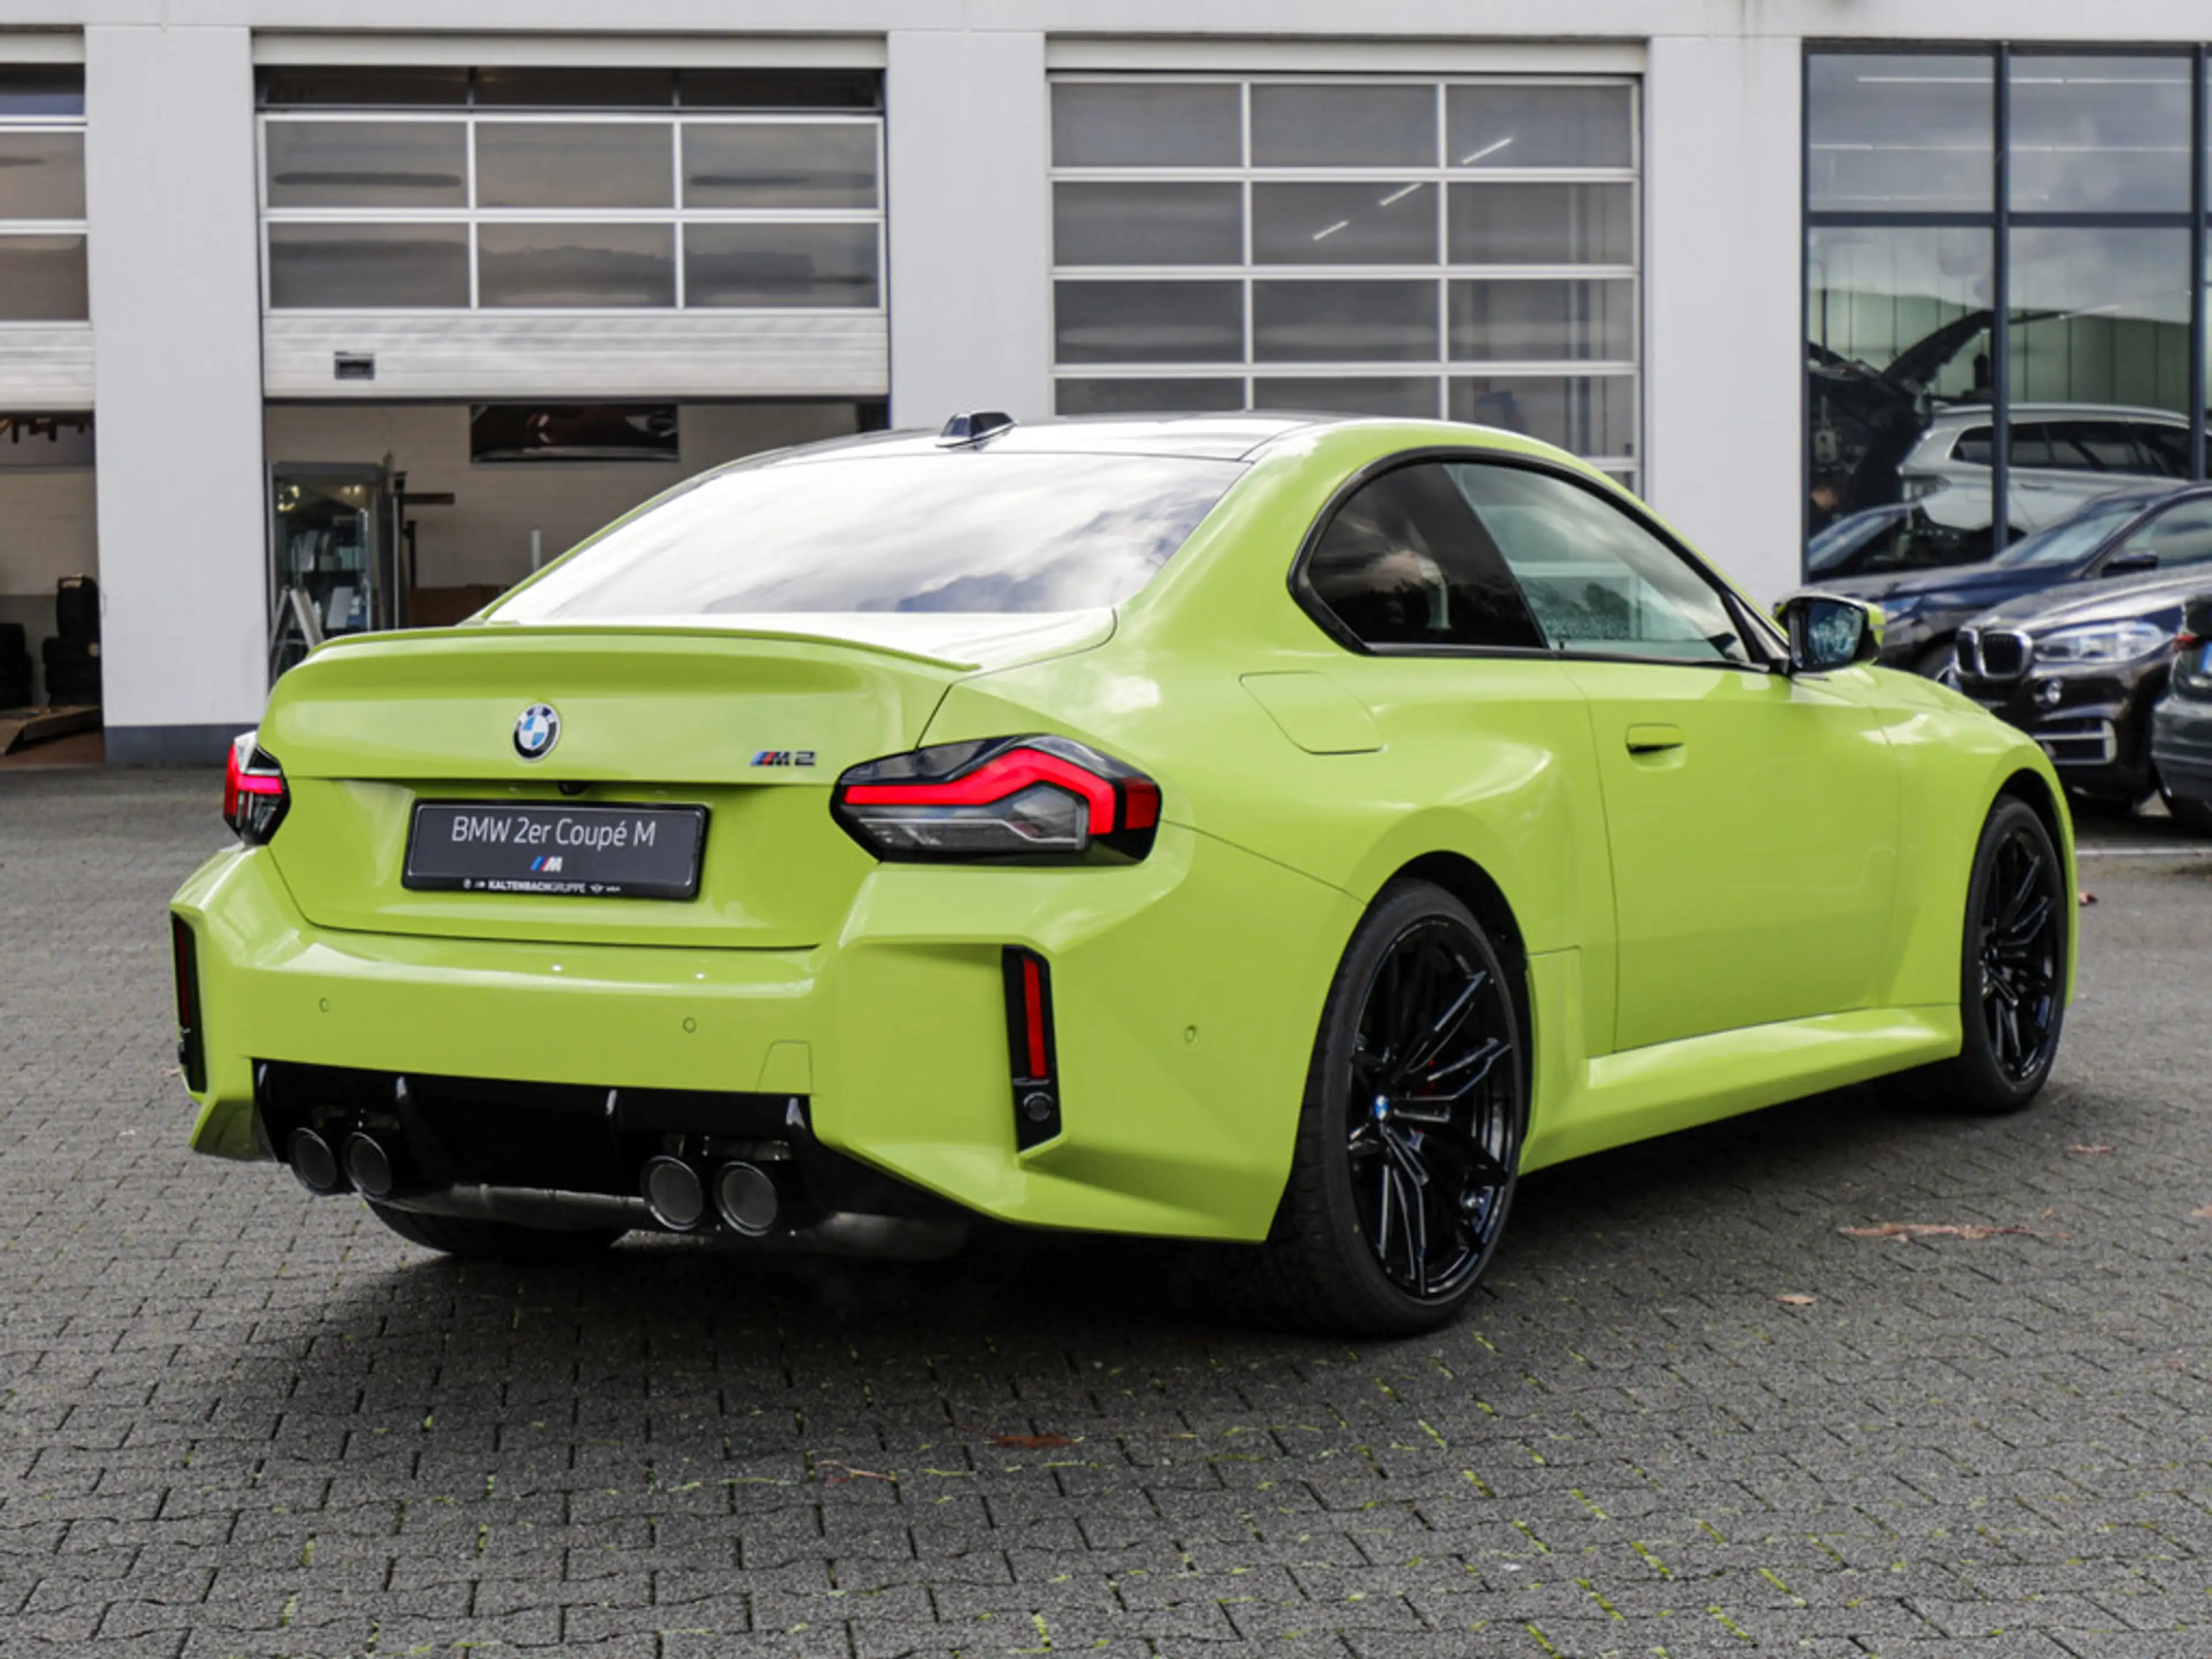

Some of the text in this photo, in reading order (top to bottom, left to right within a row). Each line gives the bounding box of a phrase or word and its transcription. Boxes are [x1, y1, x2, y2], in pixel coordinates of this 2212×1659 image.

[451, 815, 656, 852] BMW 2er Coupé M
